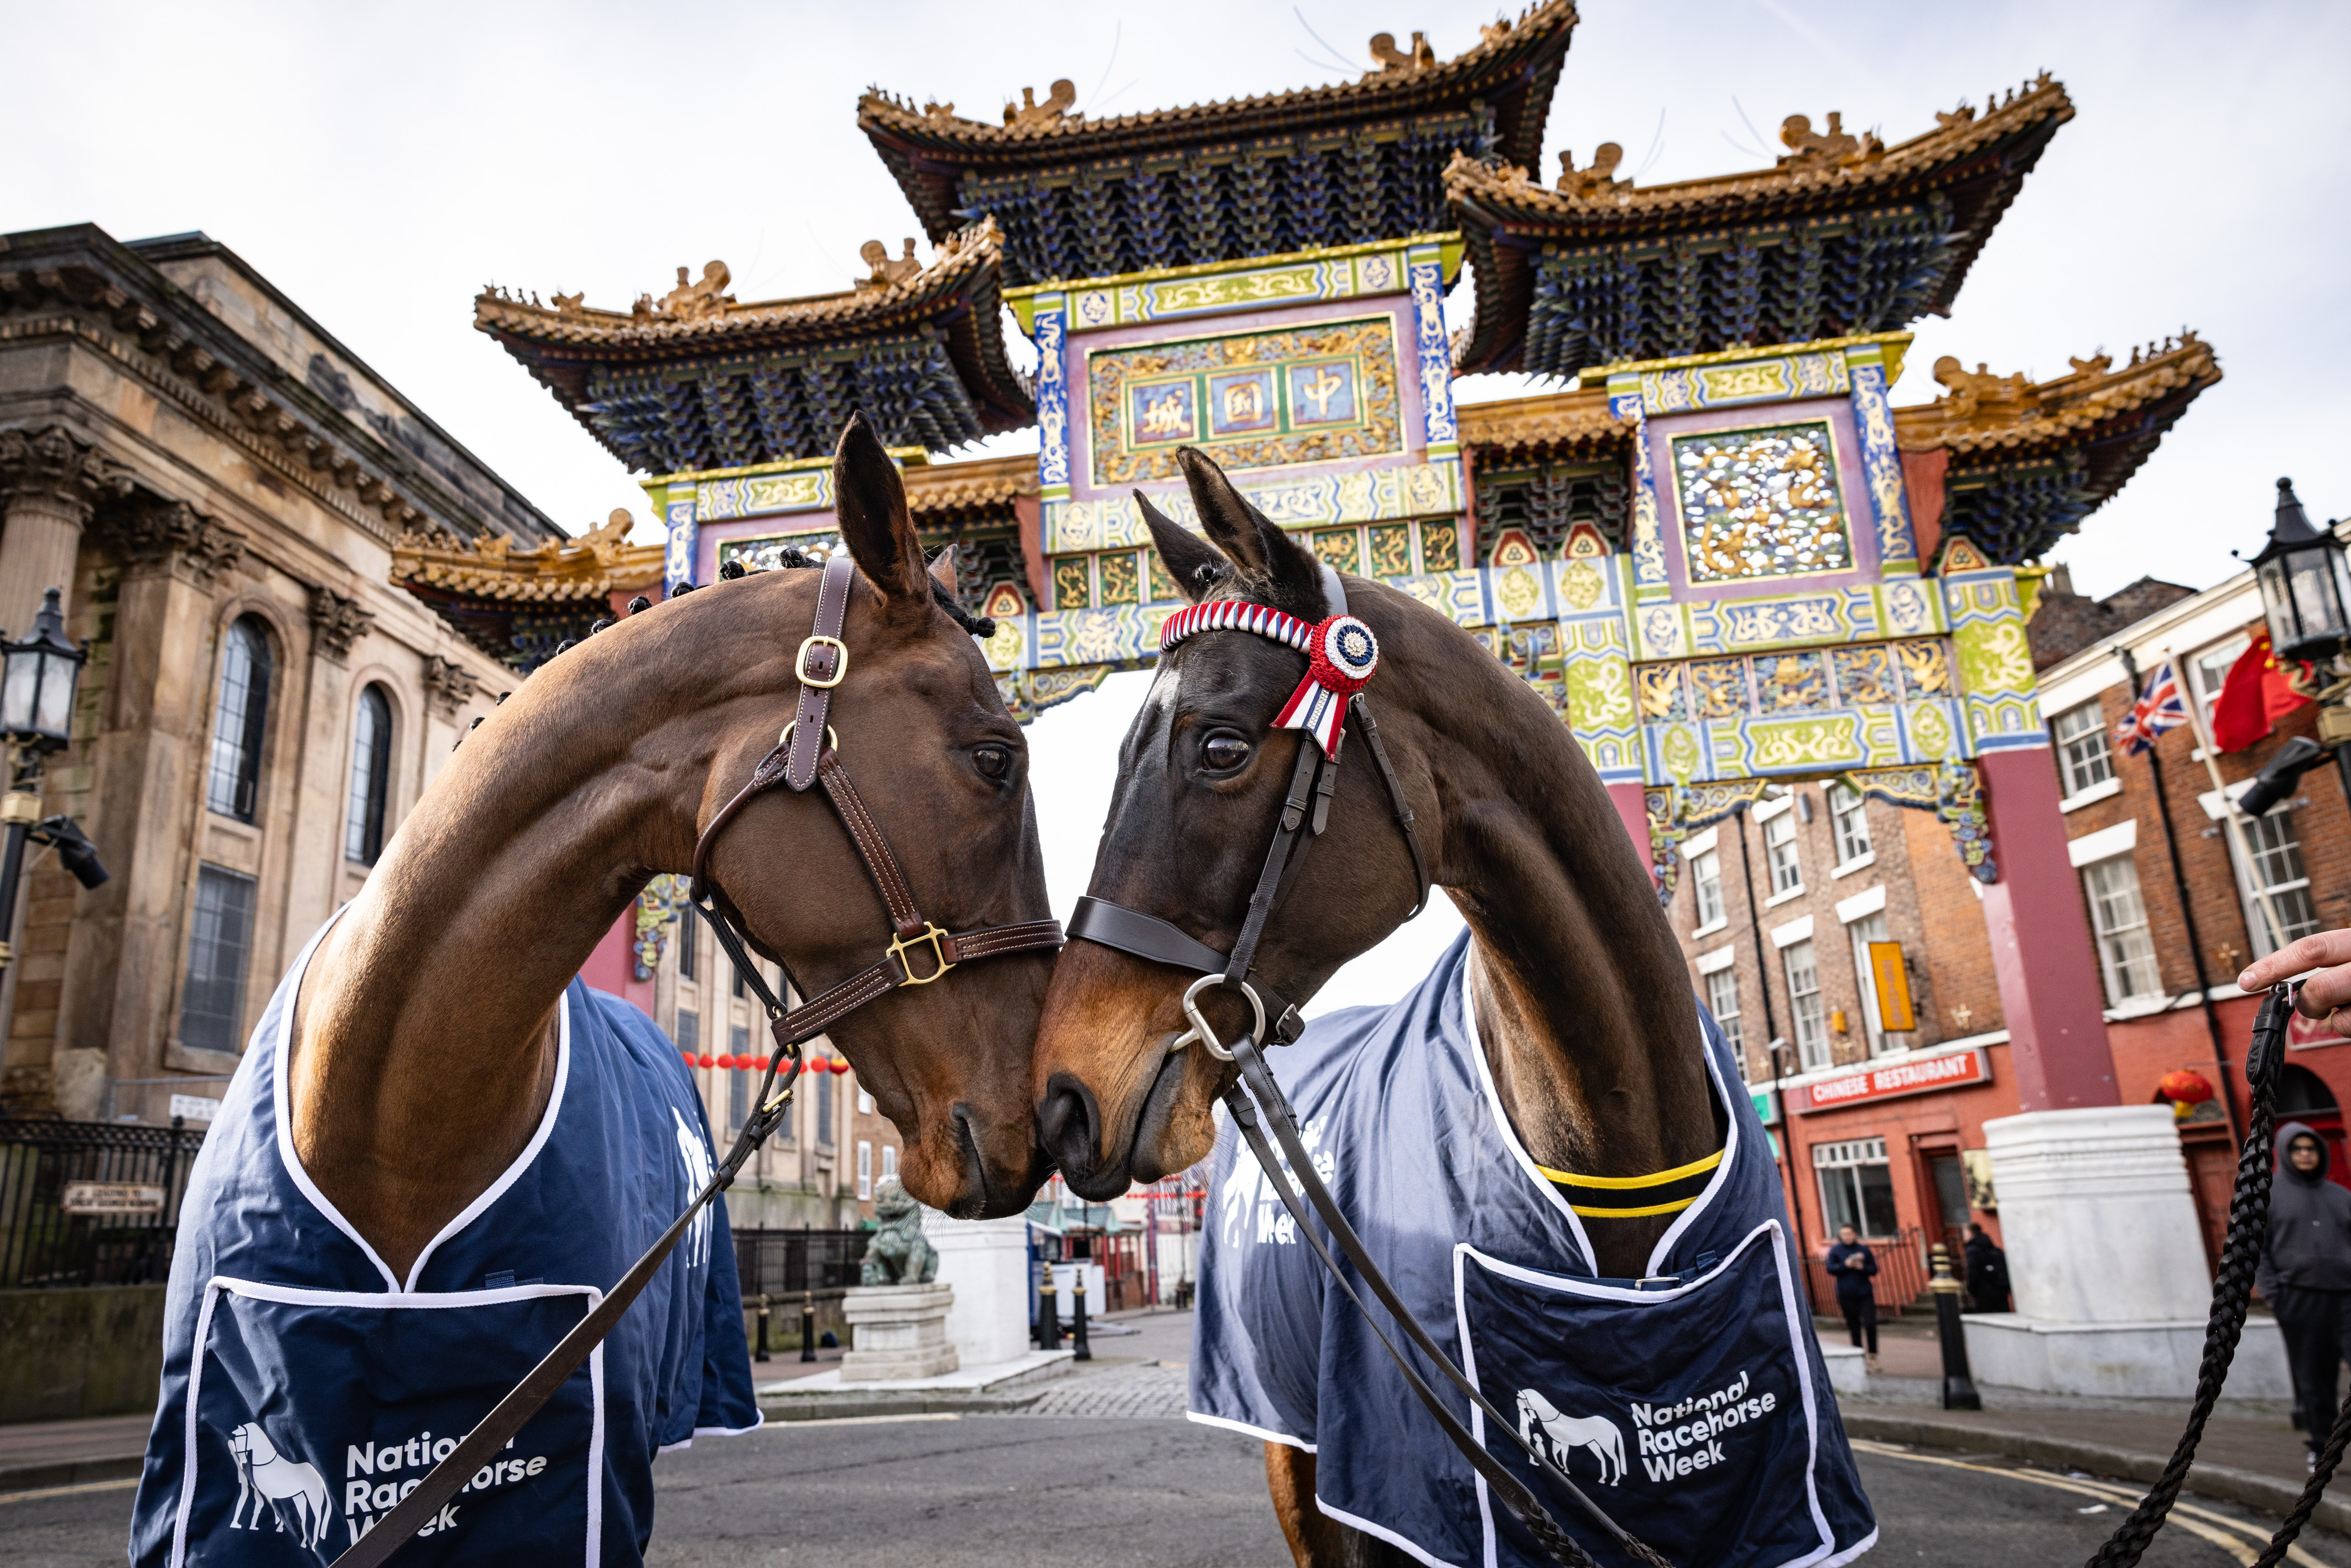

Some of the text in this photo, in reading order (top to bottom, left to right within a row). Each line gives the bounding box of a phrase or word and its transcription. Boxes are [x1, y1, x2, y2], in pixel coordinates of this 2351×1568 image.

[1813, 1055, 1967, 1102] CHINESE RESTAURANT
[1631, 1371, 1749, 1428] National
[1638, 1393, 1776, 1455] Racehorse
[347, 1431, 514, 1478] Natio
[1641, 1439, 1726, 1482] Week
